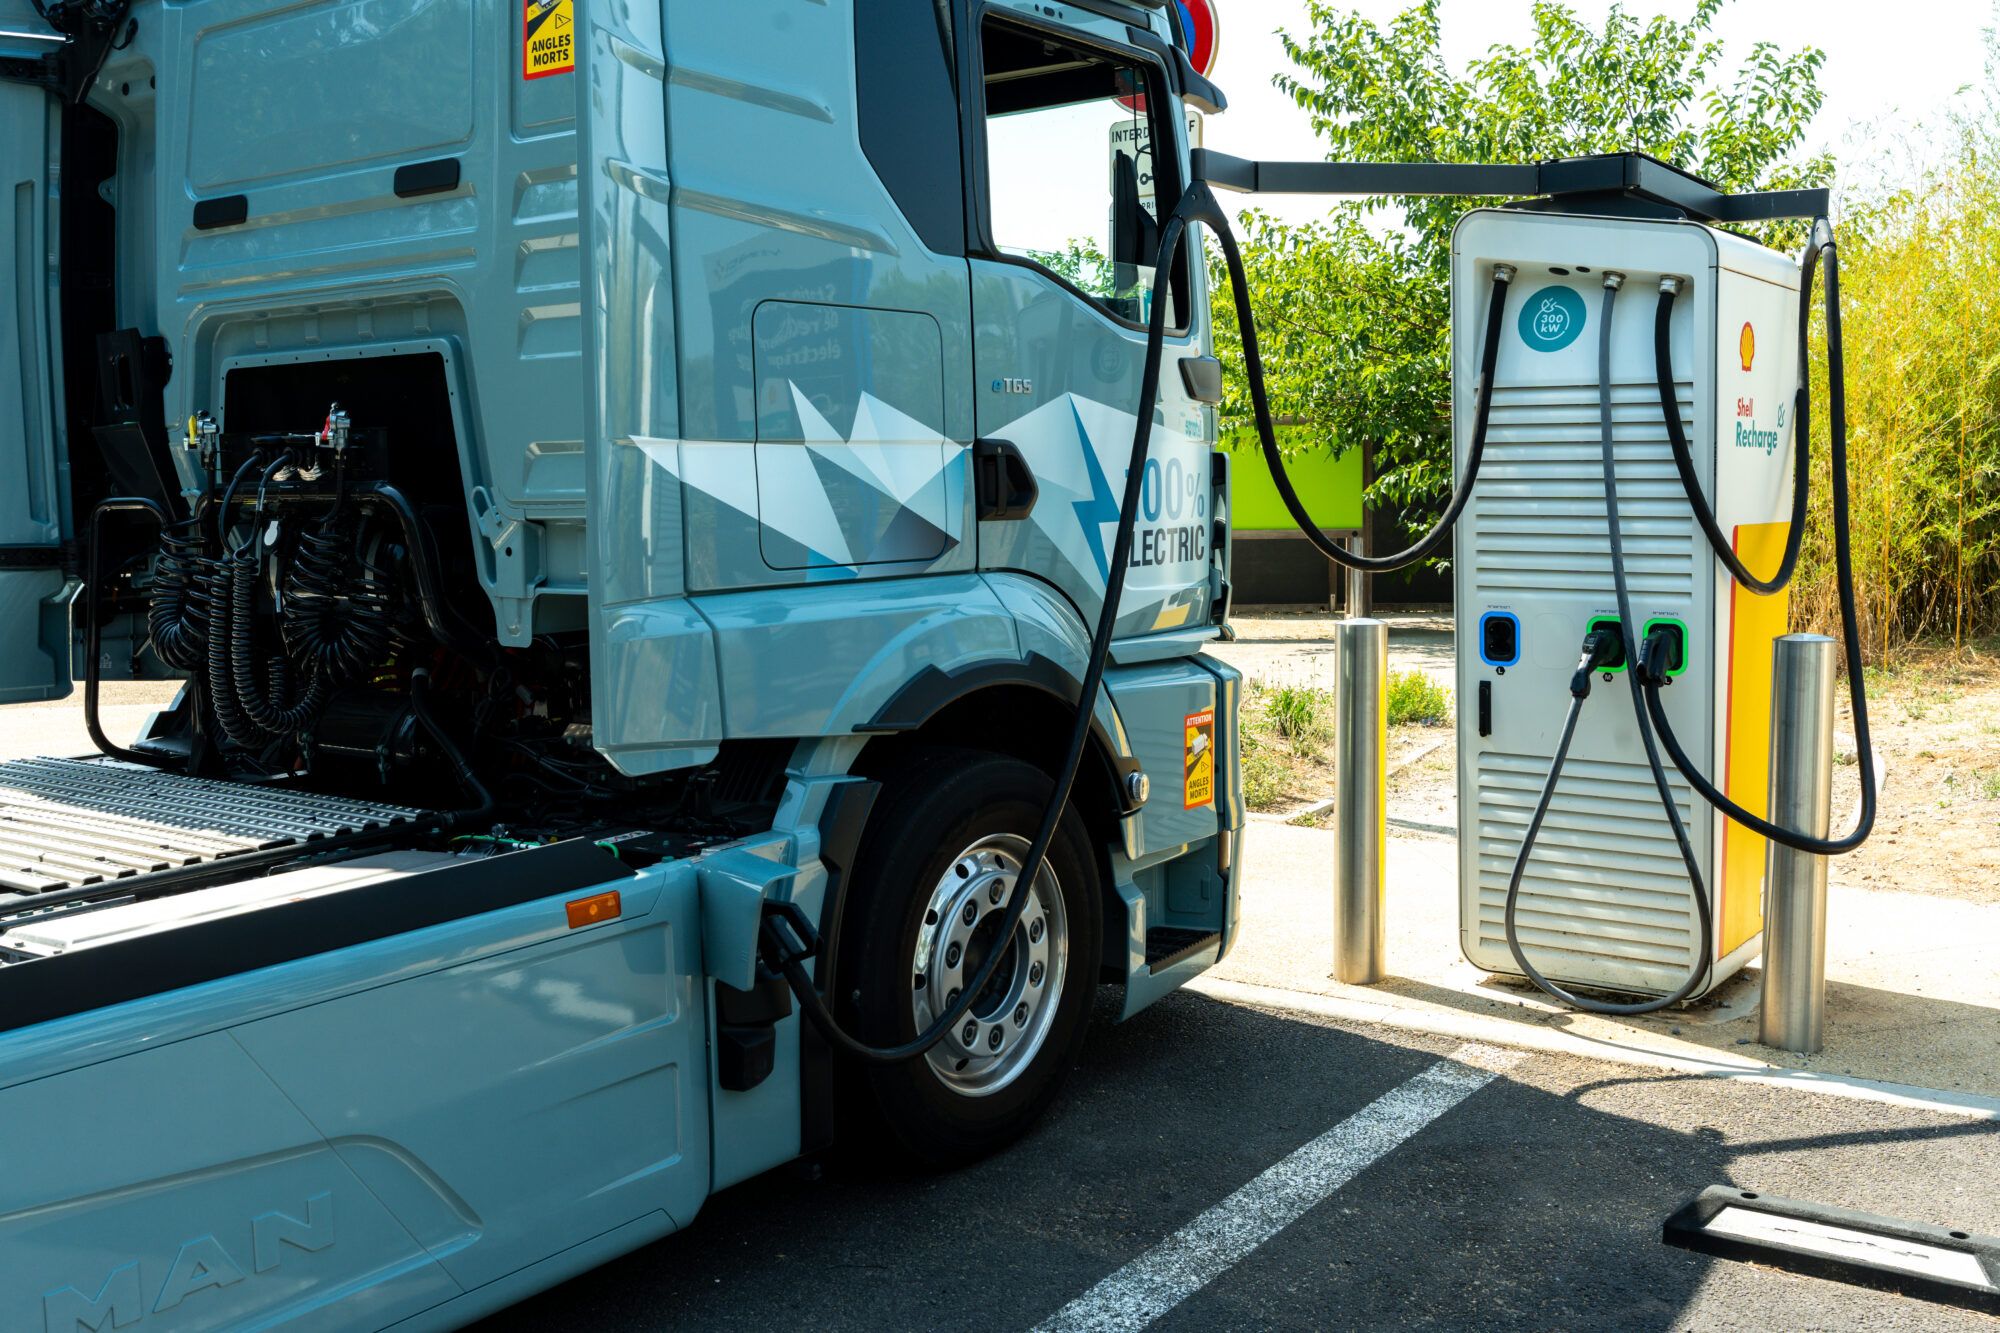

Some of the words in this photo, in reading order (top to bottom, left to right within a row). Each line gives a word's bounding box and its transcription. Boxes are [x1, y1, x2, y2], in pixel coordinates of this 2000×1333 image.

[531, 34, 571, 53] ANGLES
[533, 49, 569, 67] MORTS
[1111, 126, 1149, 143] INTERD
[1540, 314, 1564, 323] 300
[1540, 323, 1560, 333] kW
[1737, 397, 1754, 418] Shell
[1736, 420, 1778, 456] Recharge
[1125, 457, 1204, 522] 00%
[1126, 524, 1205, 568] LECTRIC
[1188, 776, 1209, 791] ANGLES
[1189, 787, 1208, 800] MORTS
[43, 1191, 335, 1333] MAN
